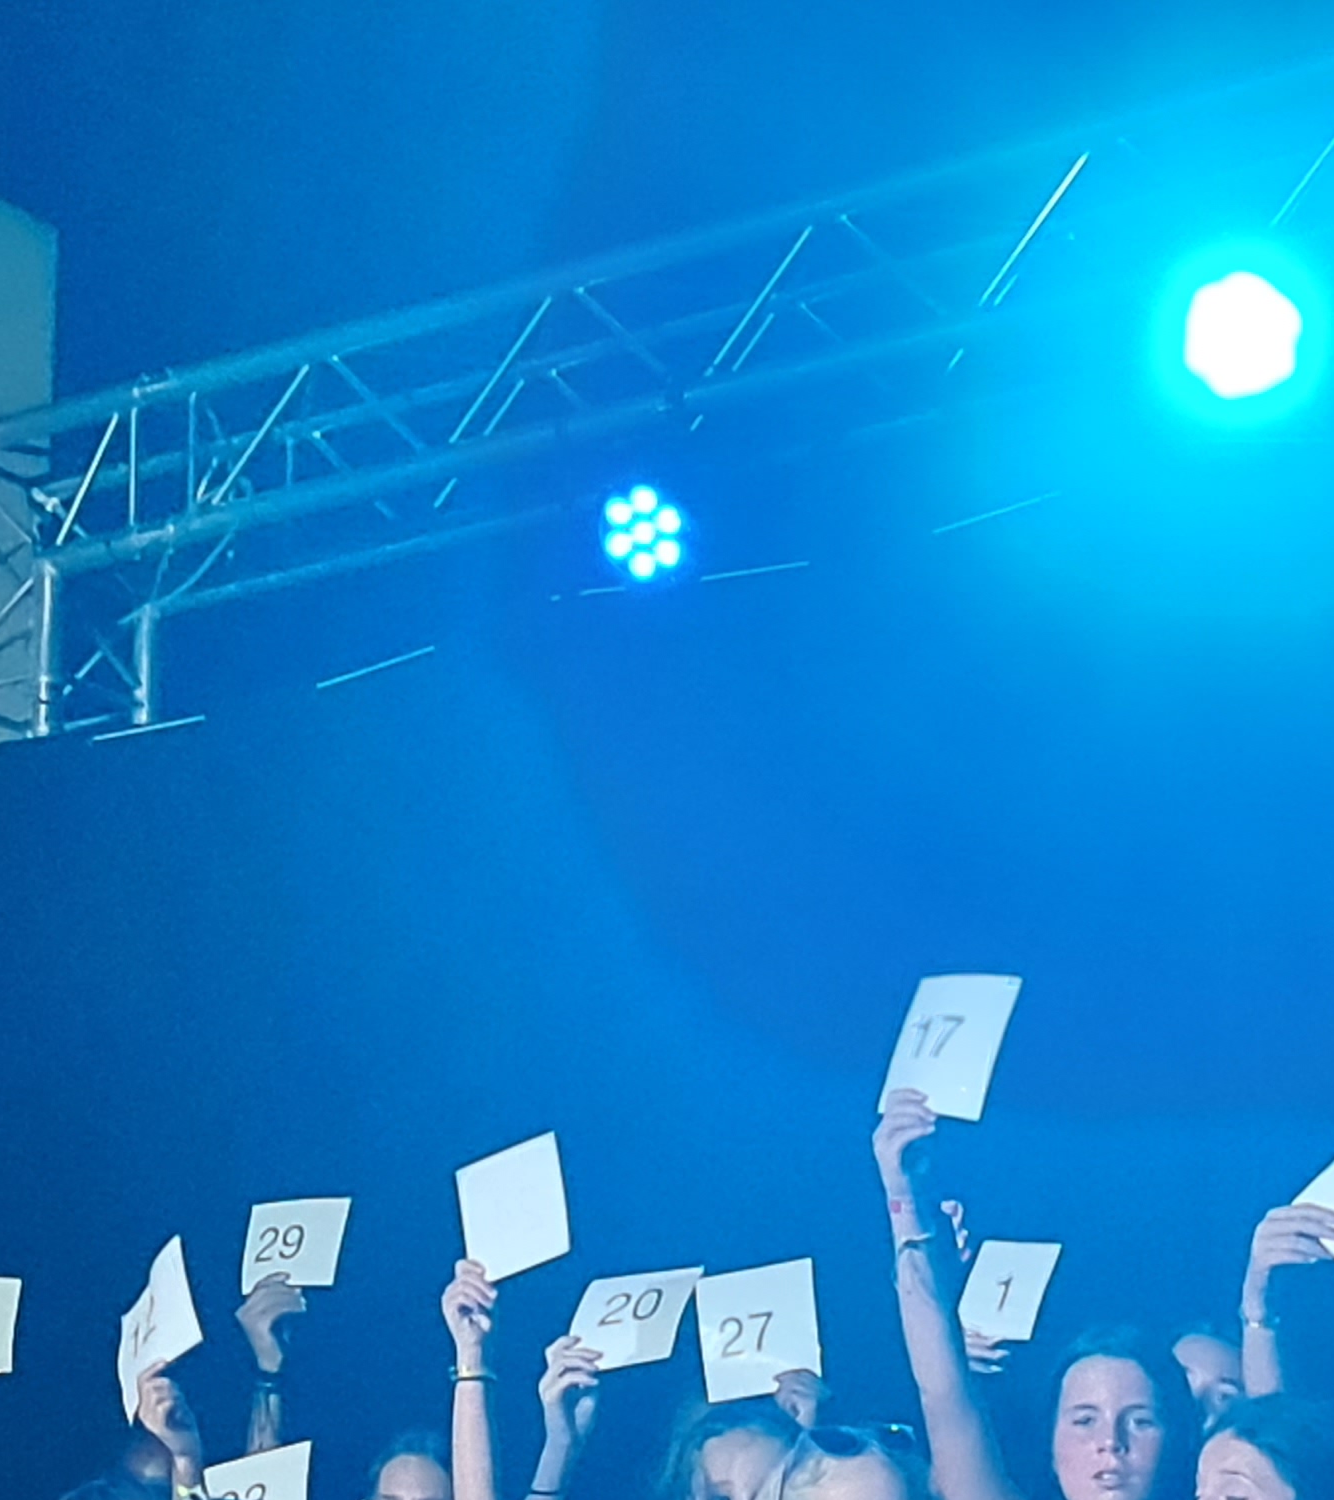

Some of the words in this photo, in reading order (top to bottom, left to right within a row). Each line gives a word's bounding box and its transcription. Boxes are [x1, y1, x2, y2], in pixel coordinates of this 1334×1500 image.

[910, 1015, 965, 1059] 17
[254, 1225, 304, 1263] 29
[598, 1288, 663, 1327] 20
[995, 1273, 1014, 1311] 1
[720, 1311, 773, 1357] 27
